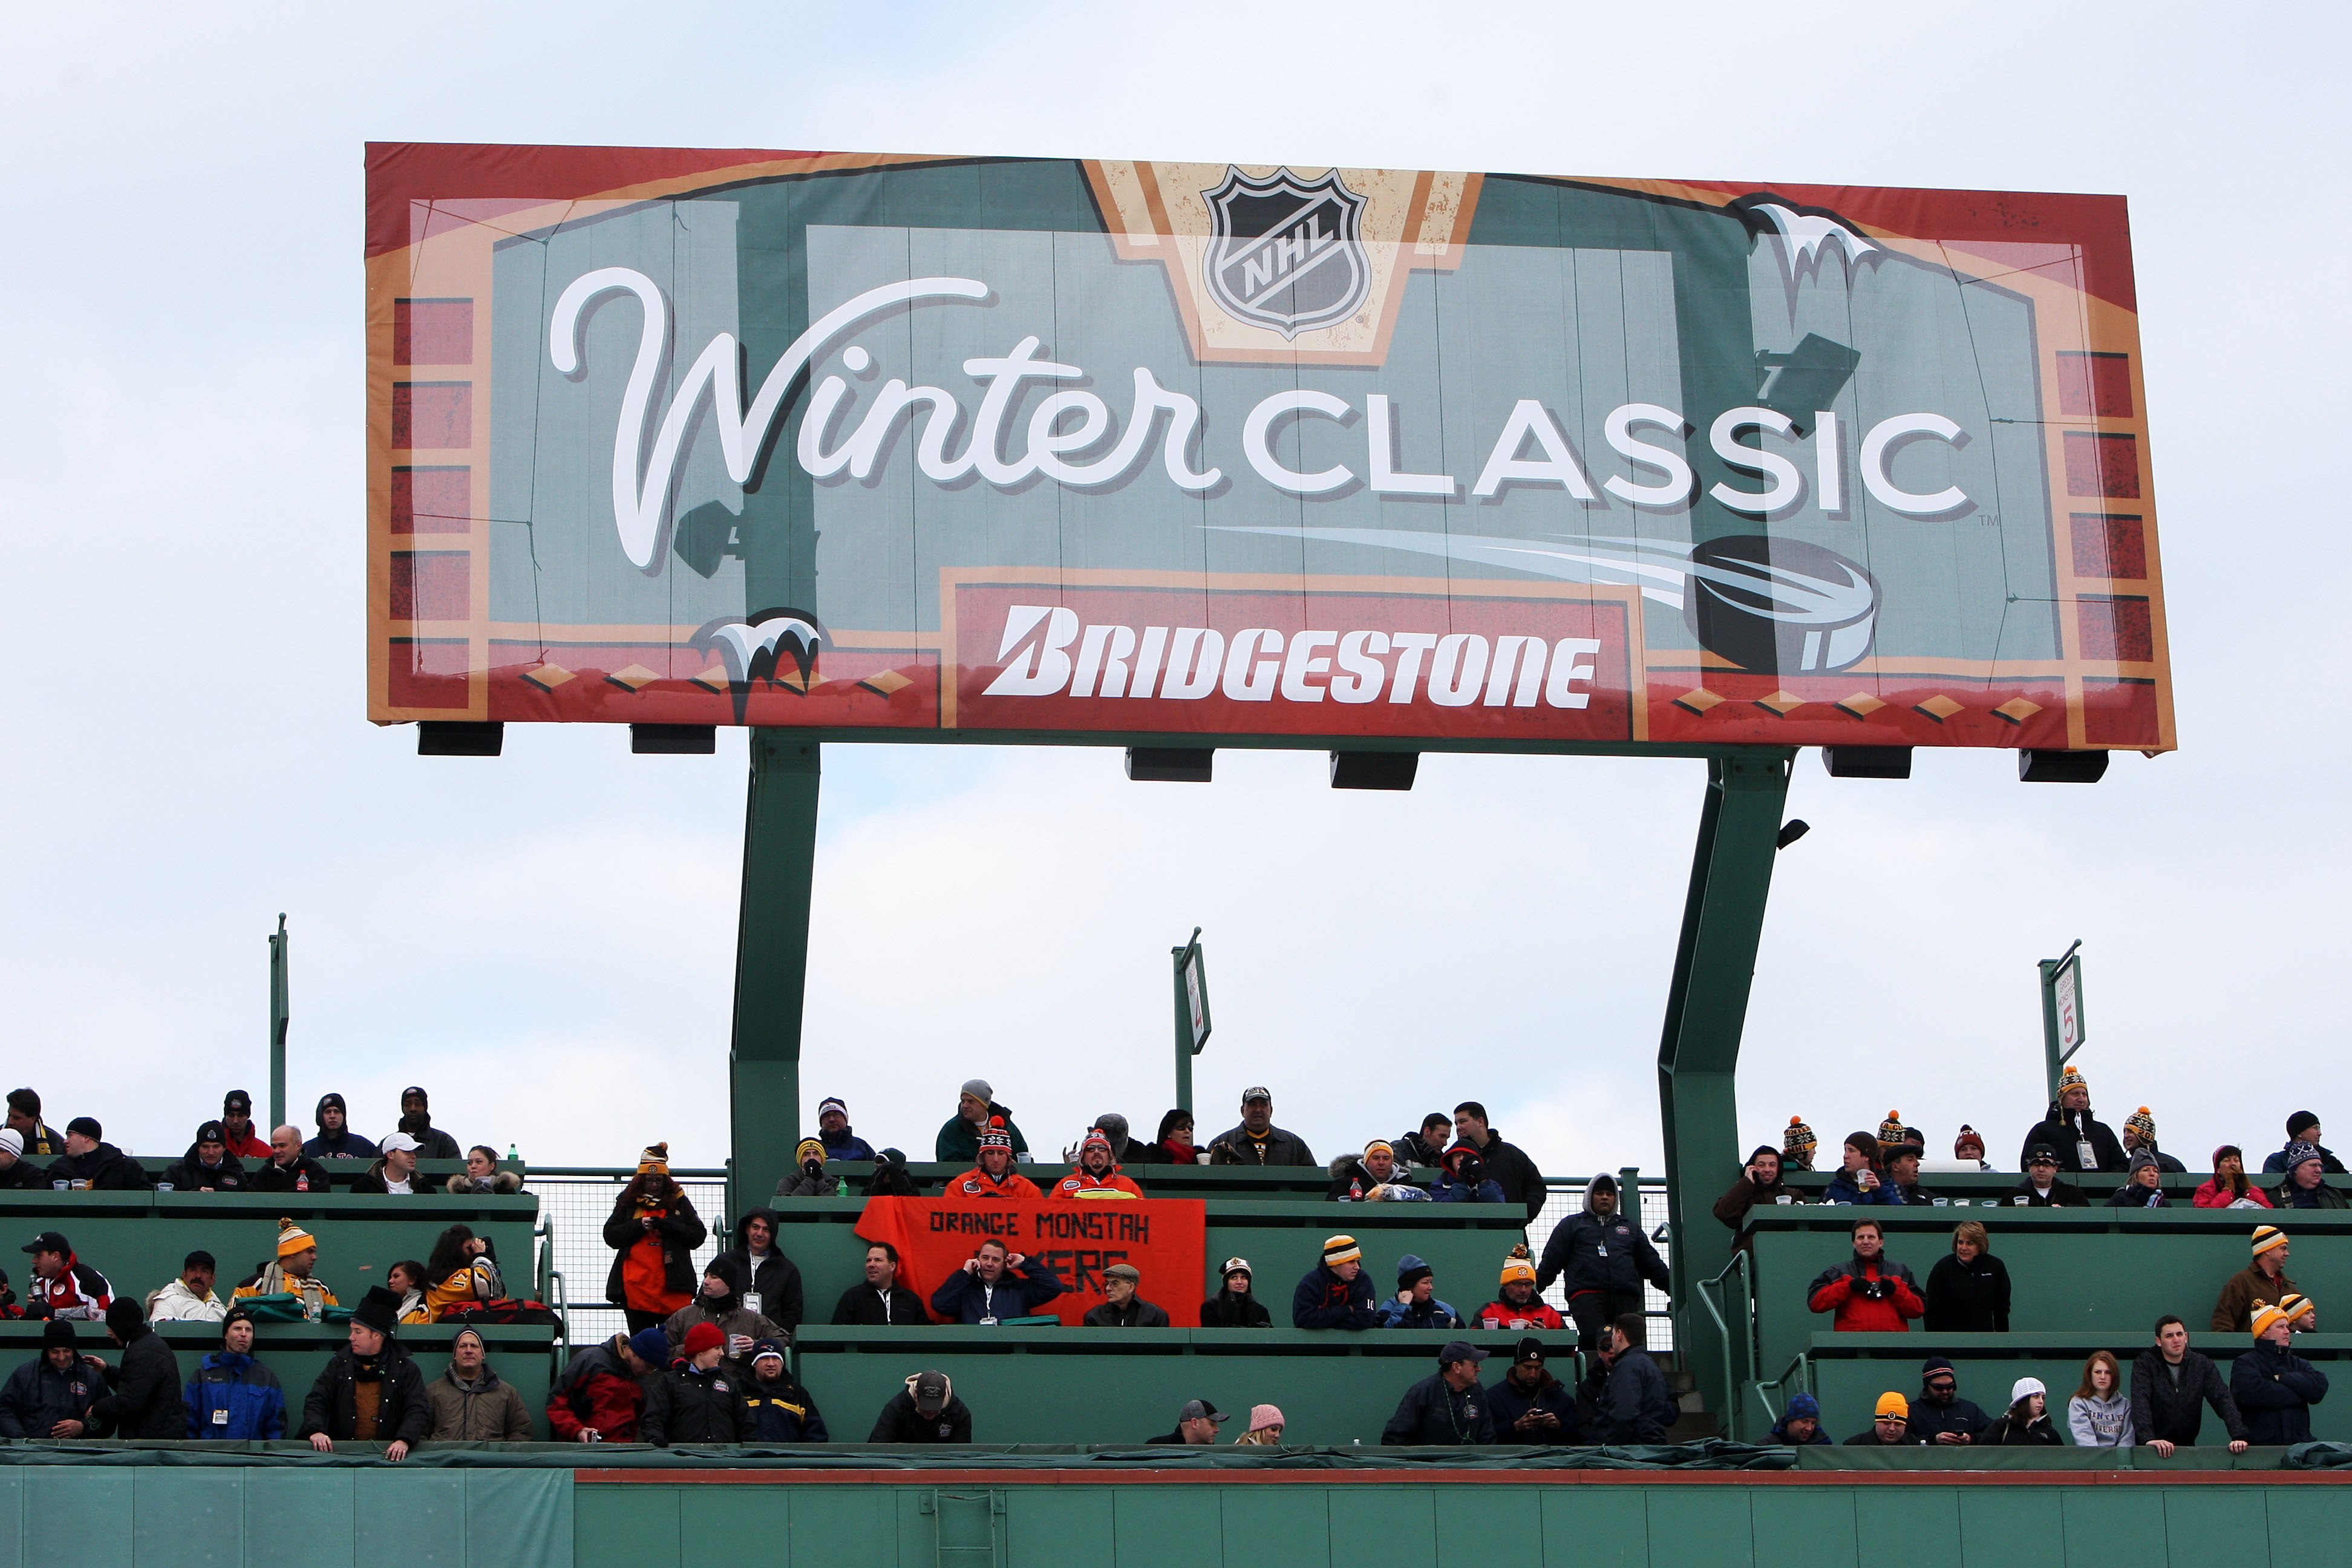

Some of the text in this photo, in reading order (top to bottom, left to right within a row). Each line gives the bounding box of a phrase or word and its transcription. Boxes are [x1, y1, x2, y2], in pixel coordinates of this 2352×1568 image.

[1242, 214, 1333, 298] NHL
[549, 266, 1970, 569] Winter CLASSIC
[1977, 514, 1999, 527] TM
[981, 604, 1601, 710] BRIDGESTONE
[2063, 1002, 2074, 1044] 5
[930, 1212, 1149, 1245] ORANGE MONSTAH
[2088, 1410, 2123, 1422] BENTLE
